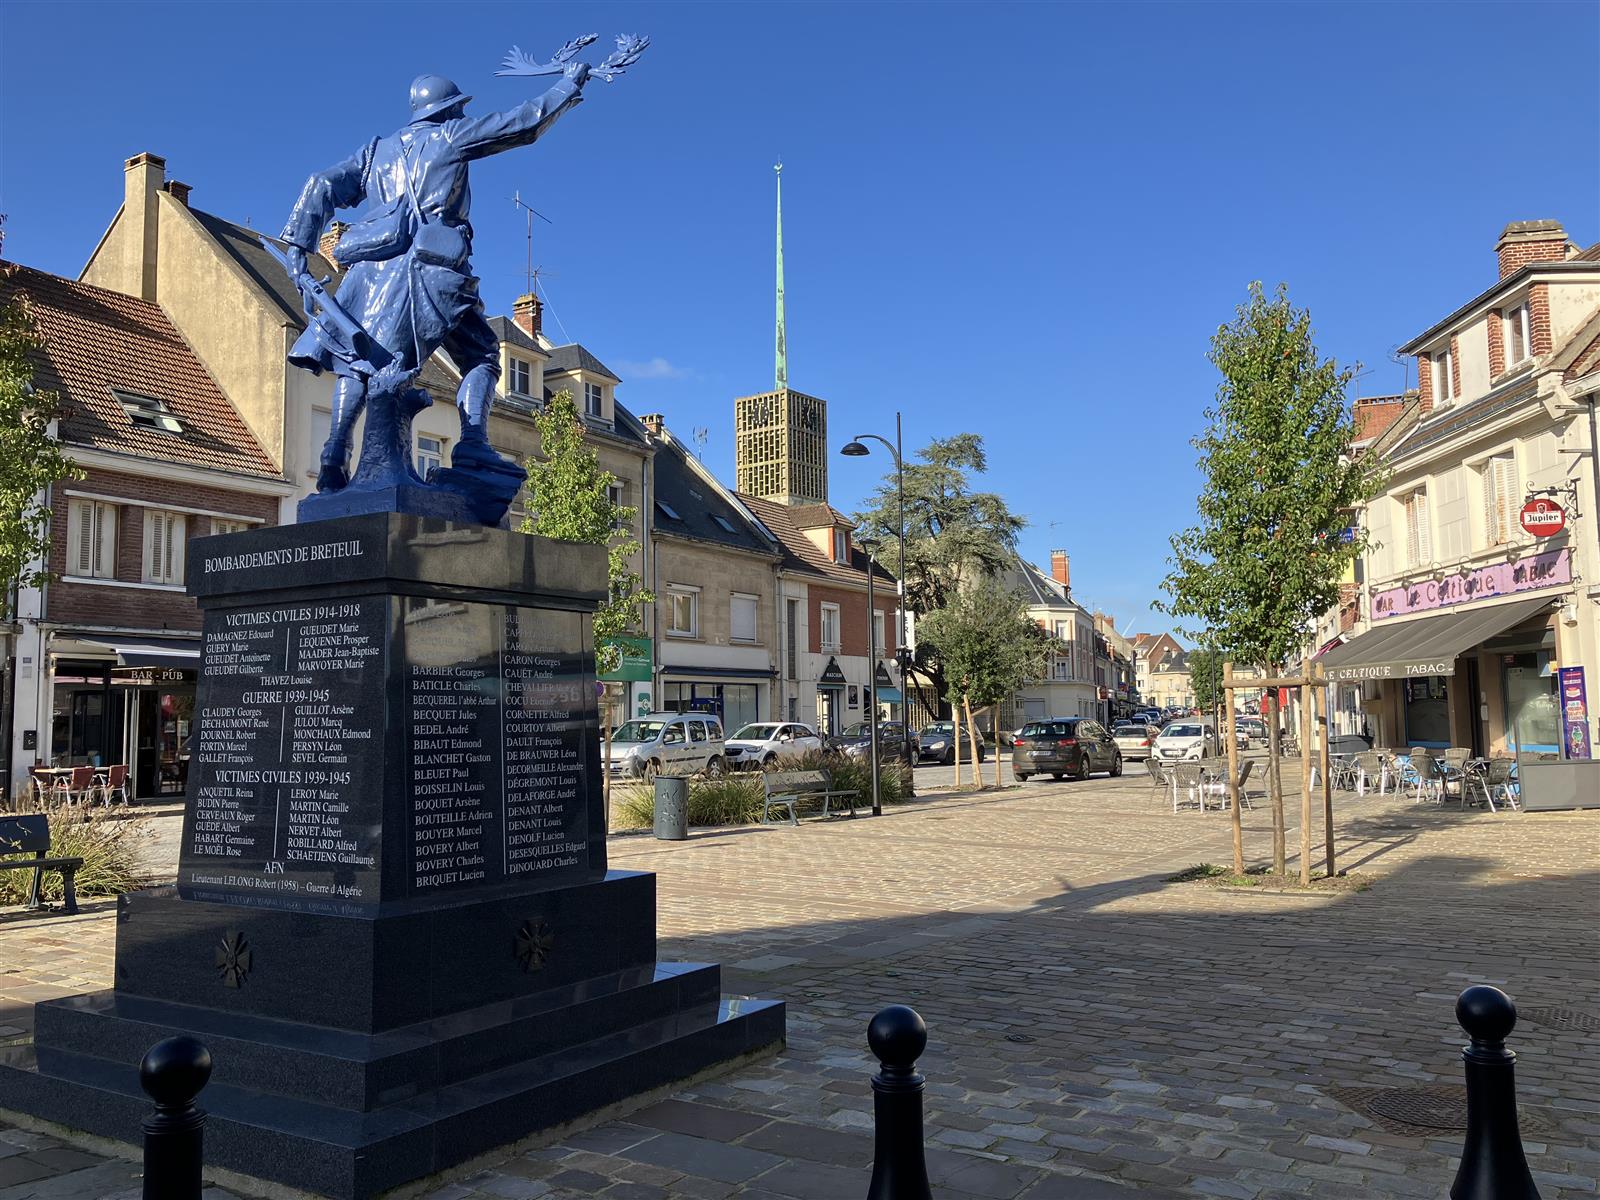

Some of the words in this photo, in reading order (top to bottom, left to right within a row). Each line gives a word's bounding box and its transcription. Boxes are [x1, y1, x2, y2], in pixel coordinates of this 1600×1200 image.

[1528, 513, 1558, 522] Jupiler
[205, 549, 292, 573] BOMBARDEMENTS
[294, 547, 309, 562] DE
[311, 540, 363, 561] BRETEUIL
[1376, 596, 1394, 612] AR
[1426, 574, 1495, 602] Cetiue
[1513, 562, 1557, 584] ABAC
[226, 612, 270, 626] VICTIMES
[272, 608, 311, 622] CIVILES
[314, 604, 360, 620] 1914-1918
[300, 624, 337, 636] GUEUDET
[339, 622, 359, 633] Marie
[207, 631, 247, 642] DAMAGNEZ
[249, 629, 274, 640] Edouard
[300, 636, 342, 648] LEQUENNE
[343, 635, 369, 646] Prosper
[206, 643, 230, 654] GUERY
[232, 642, 248, 651] Marie
[299, 649, 333, 660] MAADER
[334, 646, 379, 658] Jean-Baptiste
[205, 655, 238, 665] GUEUDET
[239, 653, 270, 663] Antoinette
[505, 655, 533, 665] CARON
[535, 657, 560, 668] Georges
[204, 666, 238, 676] GUEUDET
[239, 665, 263, 674] Gilberte
[298, 661, 343, 671] MARVOYER
[344, 659, 364, 669] Marie
[131, 670, 153, 679] BAR
[413, 666, 453, 676] BARBIER
[455, 667, 485, 679] Georges
[534, 671, 553, 679] André
[1340, 667, 1390, 679] CELTIQUE
[1405, 664, 1446, 674] TABAC
[260, 676, 289, 686] THAVEZ
[291, 676, 312, 684] Louise
[413, 680, 452, 690] BATICLE
[454, 681, 480, 690] Charles
[243, 691, 282, 704] GUERRE
[285, 689, 329, 703] 1939-1945
[413, 695, 457, 706] BECQUEREL
[202, 708, 236, 717] CLAUDEY
[237, 708, 262, 718] Georges
[295, 706, 330, 715] GUILLOT
[330, 705, 354, 715] Arsène
[414, 710, 457, 721] BECQUET
[458, 710, 477, 719] Jules
[506, 710, 548, 719] CORNETTE
[549, 710, 569, 718] Alfred
[202, 719, 252, 728] DECHAUMONT
[253, 719, 269, 728] René
[294, 718, 319, 727] JULOU
[506, 724, 544, 732] COURTOY
[294, 730, 341, 739] MONCHAUX
[342, 729, 371, 739] Edmond
[414, 725, 444, 734] BEDEL
[446, 724, 469, 734] André
[201, 731, 235, 740] DOURNEL
[236, 731, 256, 739] Robert
[200, 743, 225, 751] FORTIN
[226, 742, 247, 751] Marcel
[293, 742, 323, 751] PERSYN
[325, 742, 342, 751] Léon
[414, 740, 450, 750] BIBAUT
[452, 739, 481, 748] Edmond
[506, 737, 534, 746] DAULT
[535, 736, 562, 747] François
[199, 754, 227, 763] GALLET
[228, 754, 253, 765] François
[292, 753, 317, 763] SEVEL
[318, 753, 347, 763] Germain
[414, 753, 464, 764] BLANCHET
[466, 753, 491, 763] Gaston
[507, 752, 518, 760] DE
[520, 750, 559, 759] BRAUWER
[561, 750, 576, 758] Léon
[507, 763, 556, 774] DECORMEILLE
[557, 762, 584, 771] Alexandre
[215, 771, 260, 783] VICTIMES
[262, 771, 301, 783] CIVILES
[304, 772, 350, 784] 1939-1945
[414, 769, 451, 780] BLEUET
[453, 768, 468, 778] Paul
[560, 776, 576, 784] Louis
[198, 787, 235, 798] ANQUETIL
[291, 789, 317, 798] LEROY
[319, 790, 338, 799] Marie
[415, 783, 462, 795] BOISSELIN
[465, 782, 485, 792] Louis
[508, 790, 556, 802] DELAFORGE
[557, 789, 575, 798] André
[198, 799, 220, 808] BUDIN
[221, 800, 239, 808] Pierre
[290, 802, 321, 811] MARTIN
[322, 802, 349, 812] Camille
[415, 798, 453, 810] BOQUET
[455, 797, 480, 807] Arsène
[508, 805, 542, 816] DENANT
[543, 804, 563, 813] Albert
[197, 811, 235, 820] CERVEAUX
[236, 812, 255, 823] Roger
[289, 814, 320, 823] MARTIN
[322, 815, 339, 824] Léon
[416, 812, 467, 825] BOUTEILLE
[468, 811, 493, 821] Adrien
[221, 824, 240, 833] Albert
[508, 819, 542, 830] DENANT
[544, 817, 561, 827] Louis
[288, 826, 320, 836] NERVET
[321, 828, 342, 837] Albert
[416, 828, 454, 841] BOUYER
[456, 825, 482, 836] Marcel
[543, 831, 565, 840] Lucien
[195, 834, 224, 843] HABART
[225, 835, 255, 845] Germaine
[288, 838, 334, 849] ROBILLARD
[335, 840, 357, 851] Alfred
[194, 845, 205, 853] LE
[226, 848, 241, 856] Rose
[416, 843, 454, 856] BOVERY
[456, 841, 479, 851] Albert
[509, 844, 564, 859] DESESQUELLES
[566, 841, 586, 852] Edgard
[338, 853, 374, 865] Guillaume
[416, 858, 455, 871] BOVERY
[456, 855, 484, 866] Charles
[509, 859, 552, 873] DINOUARD
[554, 856, 578, 866] Charles
[264, 862, 284, 874] AFN
[192, 874, 223, 884] Lieutenant
[224, 876, 254, 887] LELONG
[255, 878, 276, 888] Robert
[306, 883, 330, 893] Guerre
[416, 872, 458, 887] BRIQUET
[459, 870, 484, 880] Lucien
